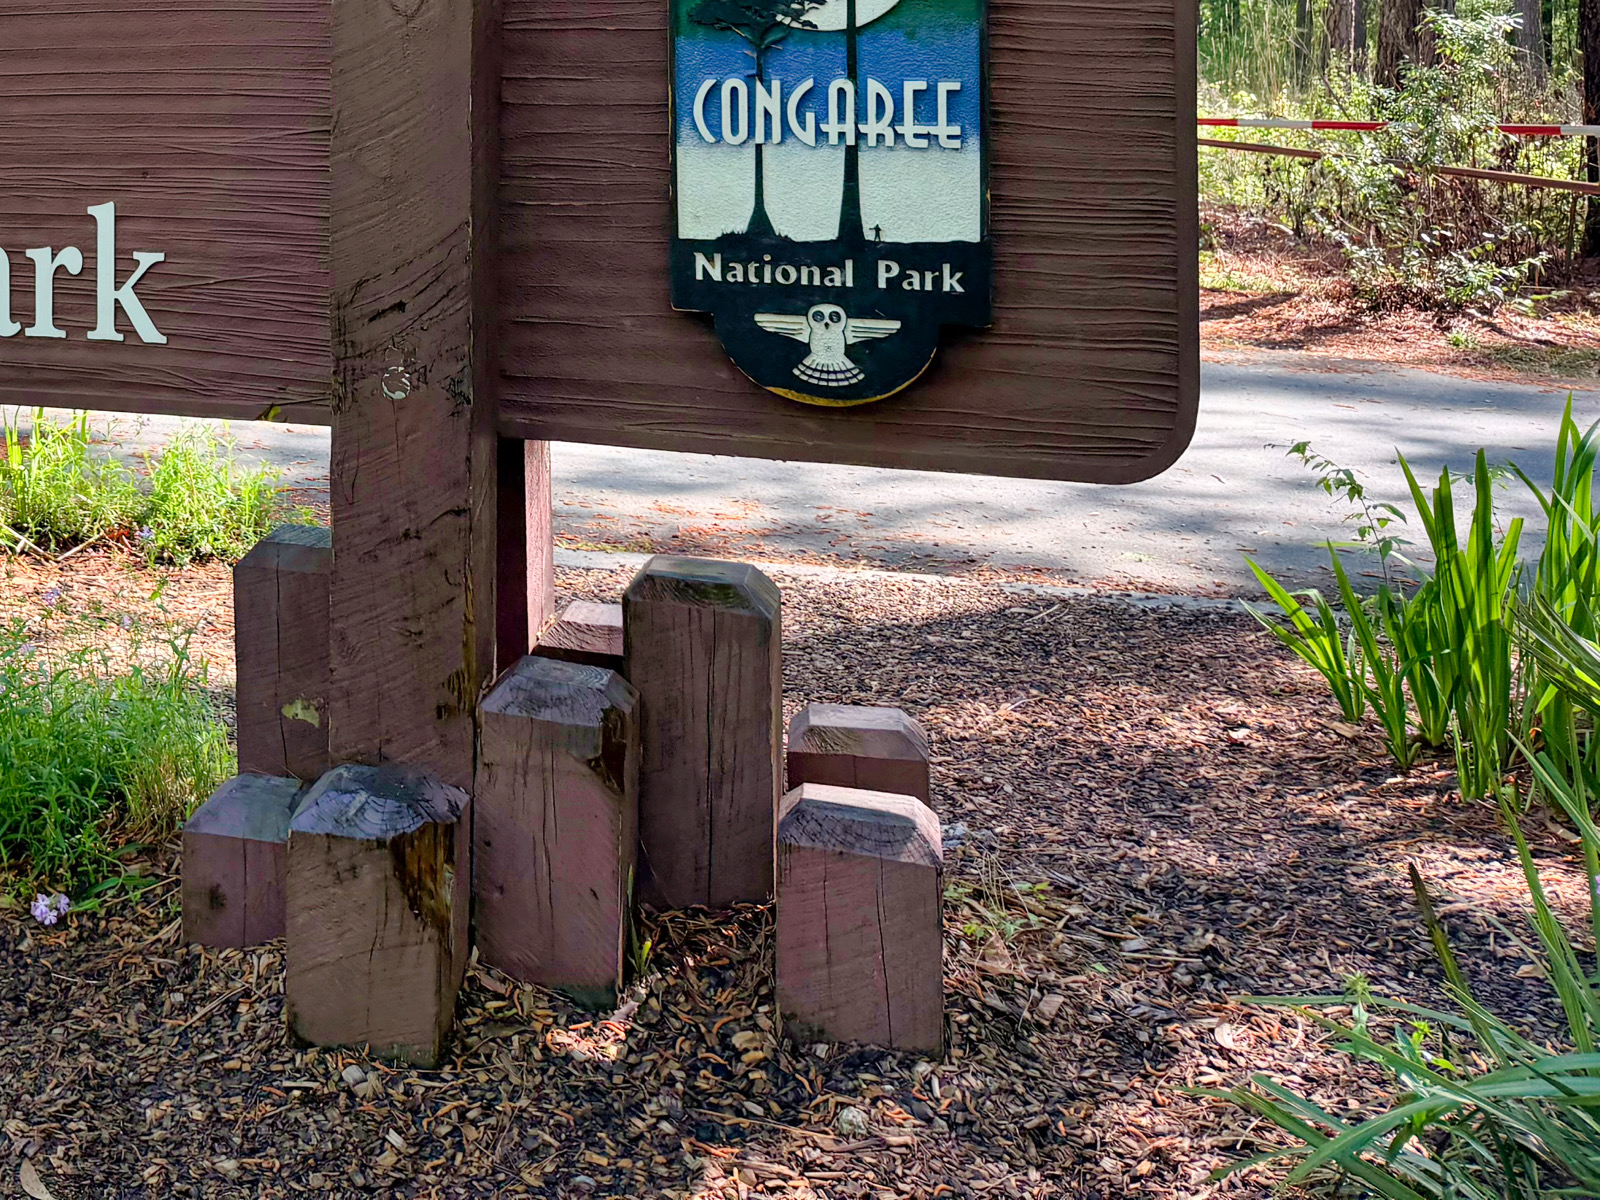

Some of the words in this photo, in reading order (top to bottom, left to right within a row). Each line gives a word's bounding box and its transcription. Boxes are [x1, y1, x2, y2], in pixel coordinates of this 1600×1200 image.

[694, 78, 962, 149] CONGAREE
[694, 251, 855, 288] National
[877, 259, 966, 295] Park
